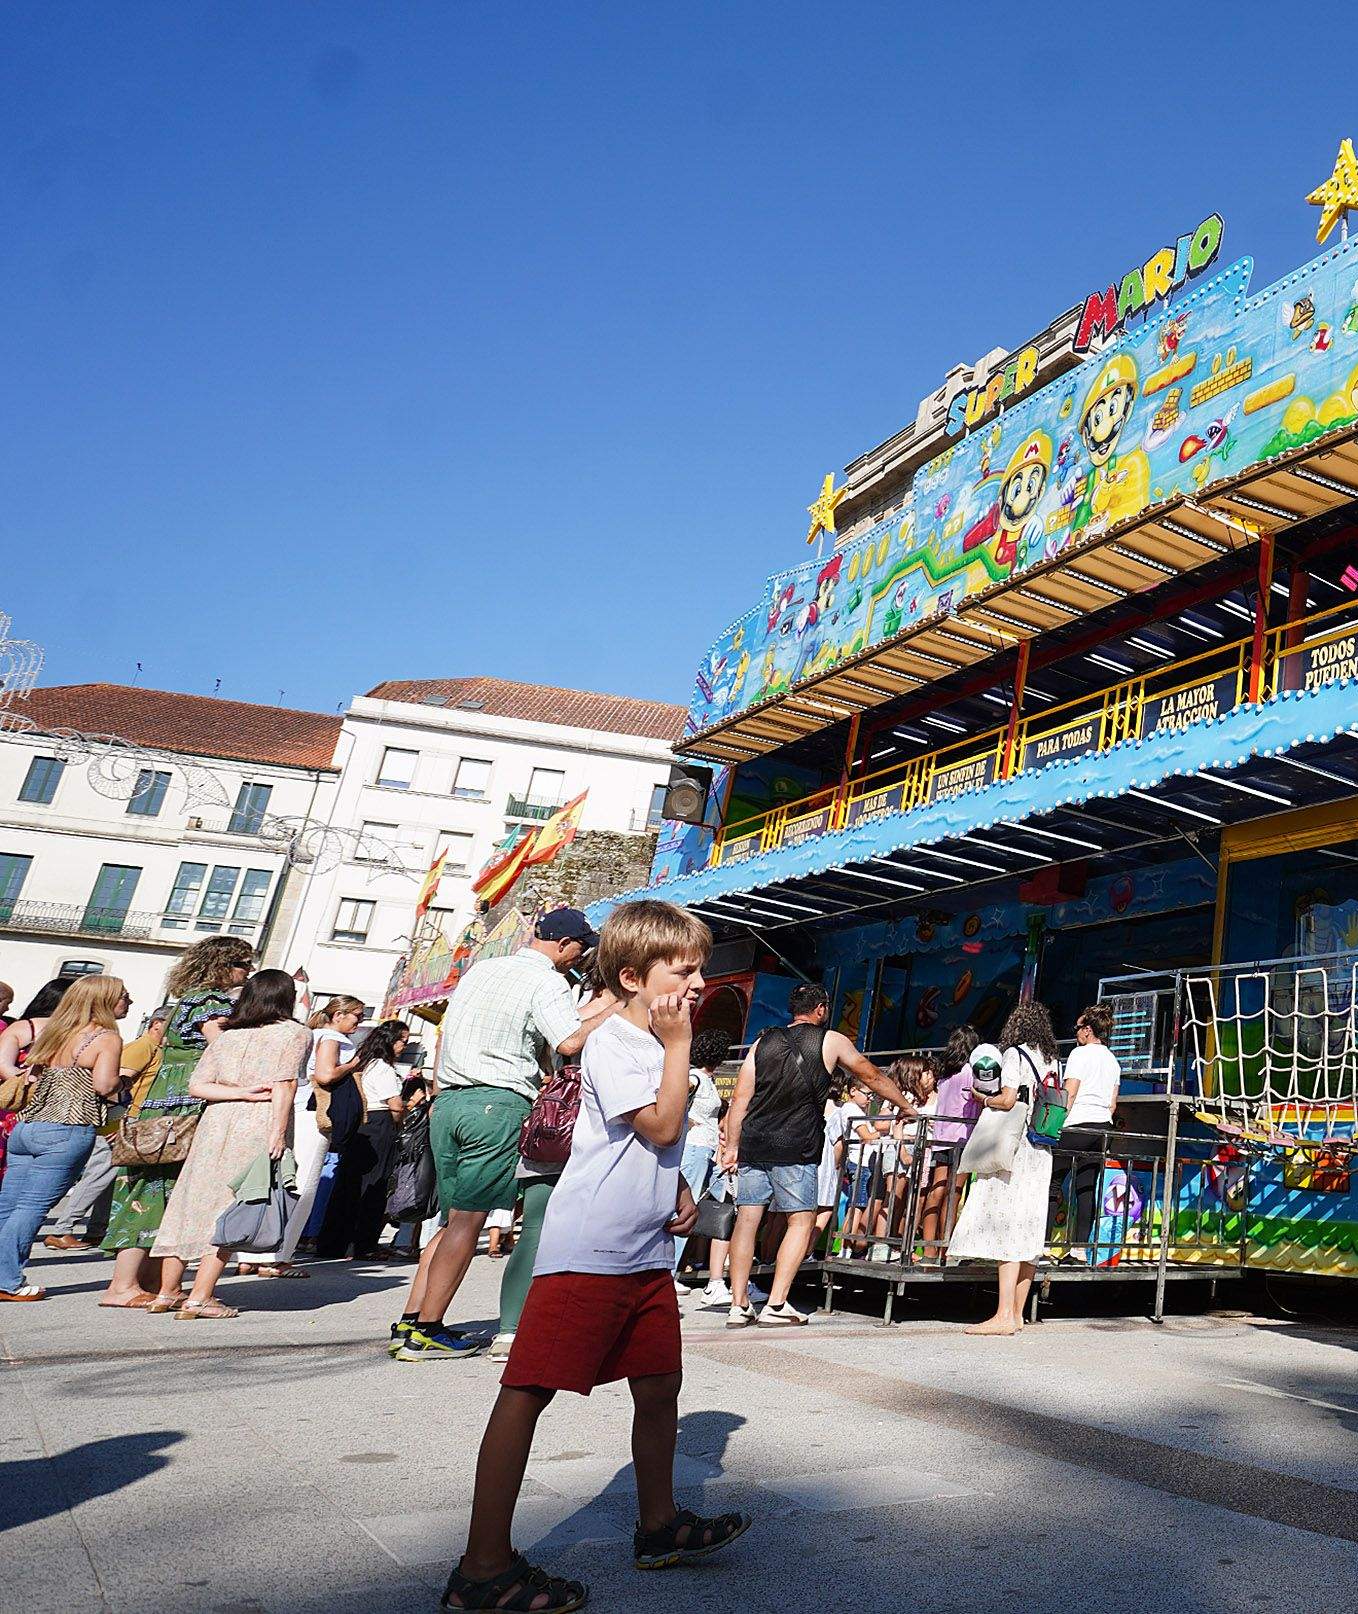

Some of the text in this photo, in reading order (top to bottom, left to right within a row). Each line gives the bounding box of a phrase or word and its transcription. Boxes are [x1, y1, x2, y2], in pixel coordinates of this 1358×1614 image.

[944, 212, 1225, 437] SUPER MARIO
[1025, 443, 1039, 459] M
[1311, 637, 1355, 668] TODOS
[1305, 657, 1358, 691] PUEDEN
[1160, 684, 1215, 717] LA MAYOR
[1036, 726, 1093, 758] PARA TODAS
